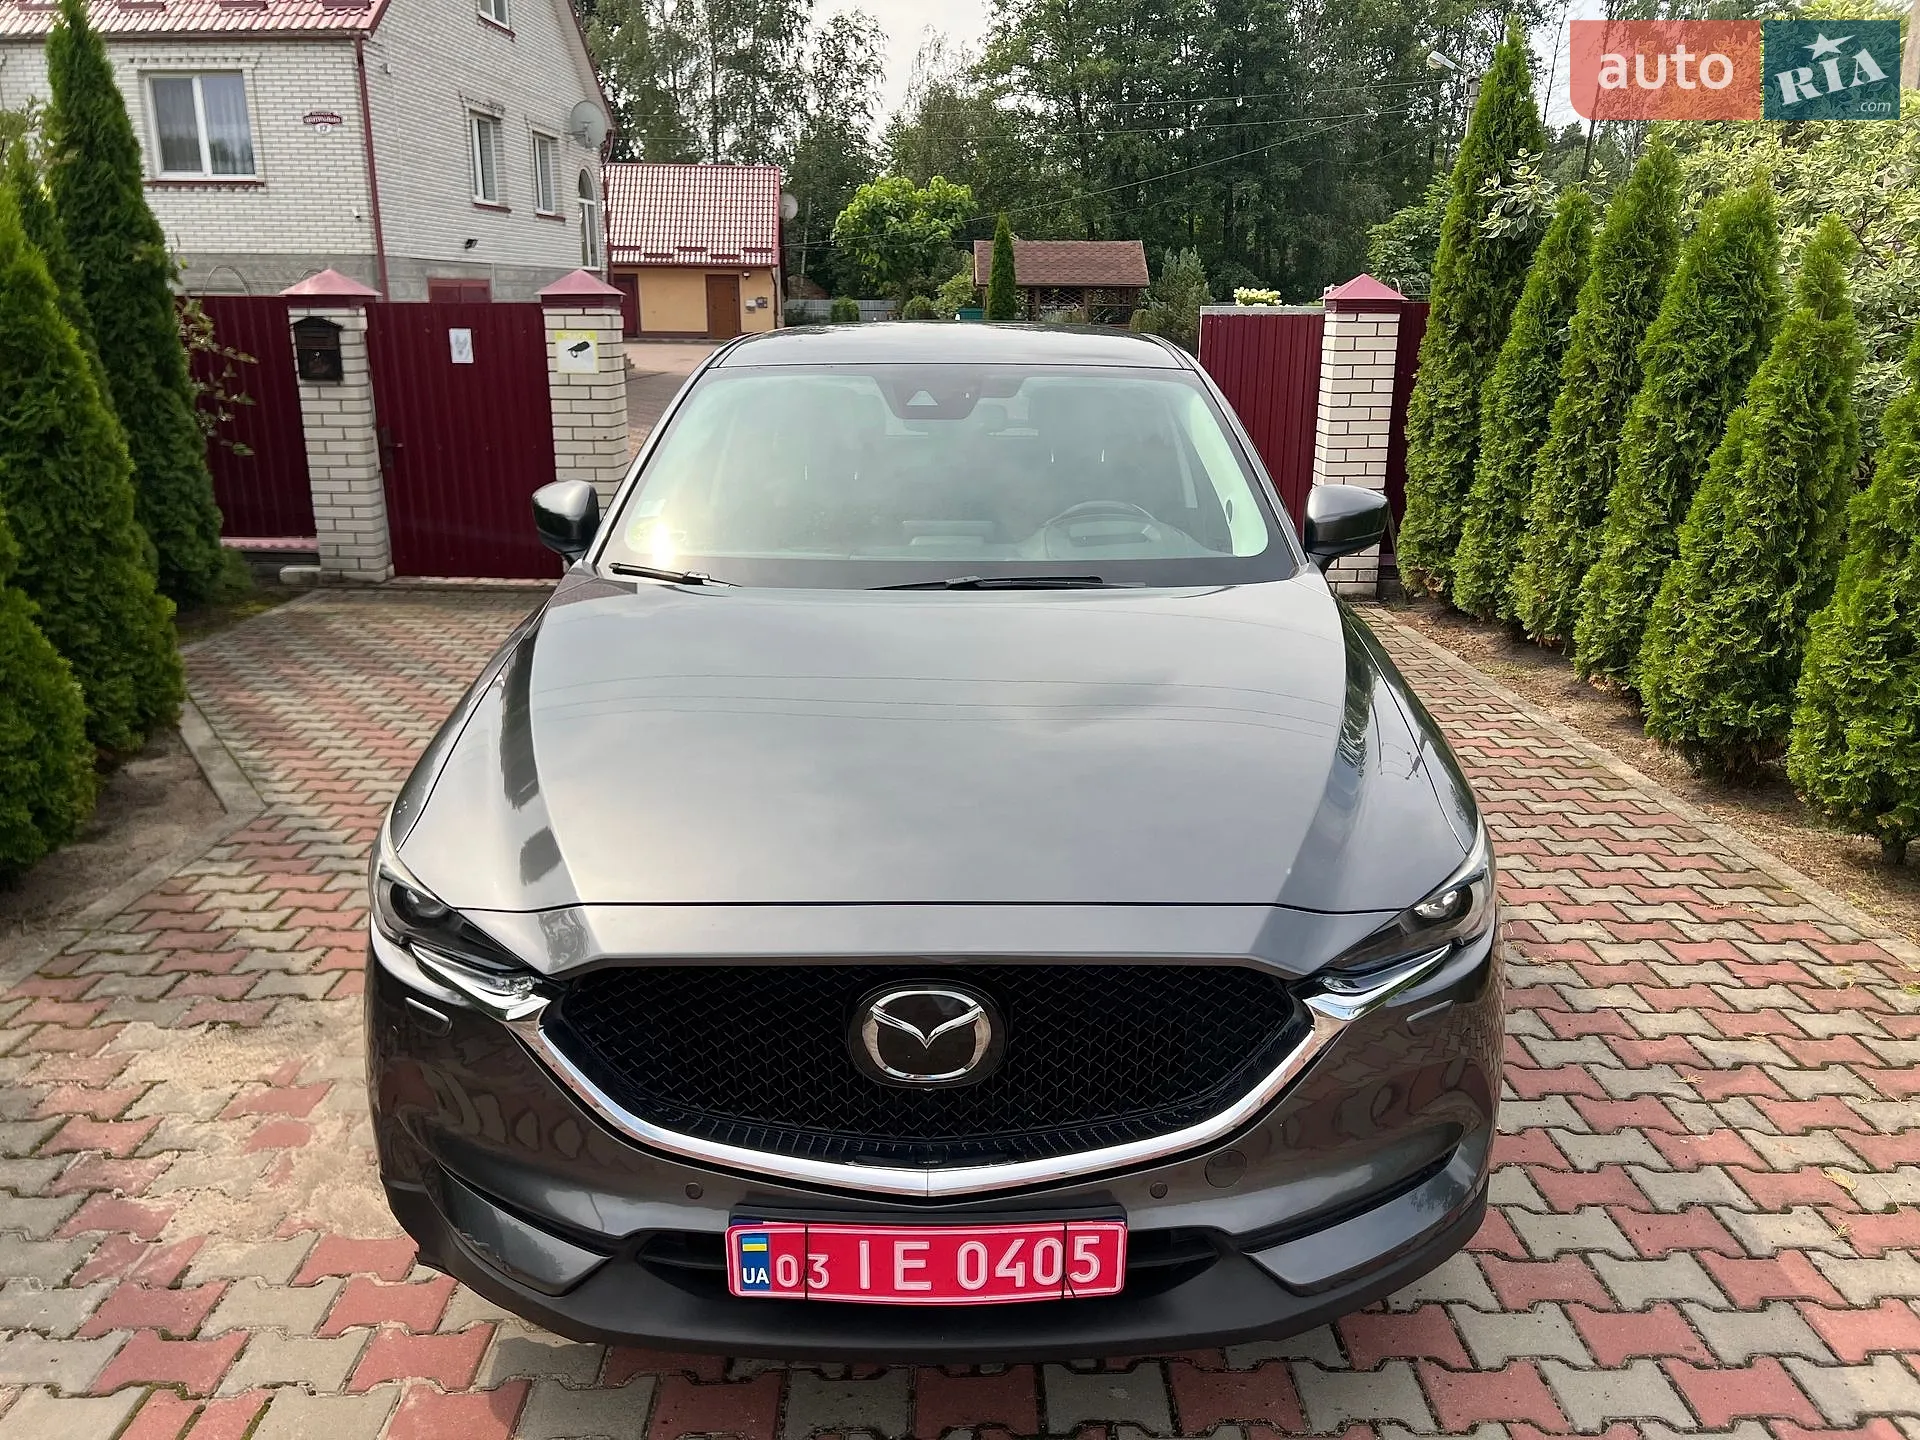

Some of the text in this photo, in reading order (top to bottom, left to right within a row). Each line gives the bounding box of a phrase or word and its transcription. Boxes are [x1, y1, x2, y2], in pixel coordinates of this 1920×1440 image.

[742, 1267, 770, 1285] UA
[775, 1253, 830, 1290] 03
[956, 1235, 1101, 1291] 0405
